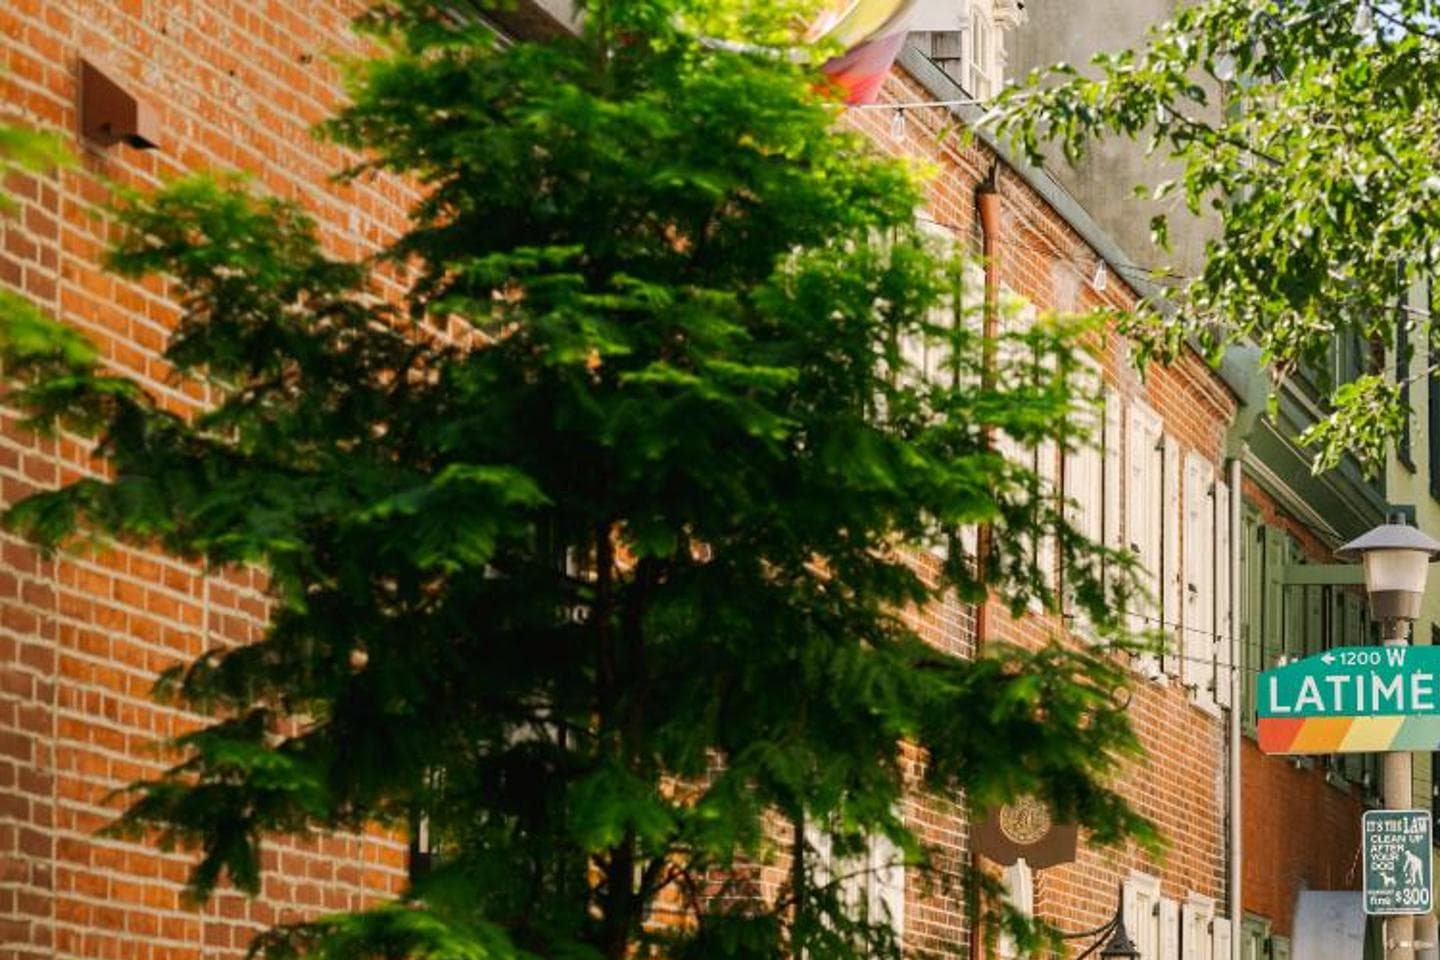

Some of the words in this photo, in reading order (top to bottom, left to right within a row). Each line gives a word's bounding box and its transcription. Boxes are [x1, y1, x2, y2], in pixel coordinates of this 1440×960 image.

[1340, 651, 1381, 666] 1200
[1385, 648, 1407, 667] W
[1403, 816, 1428, 834] LAW
[1370, 835, 1406, 843] CLEAN
[1409, 834, 1424, 843] UP
[1370, 844, 1404, 852] AFTER
[1370, 853, 1399, 861] YOUR
[1371, 862, 1395, 870] DOG
